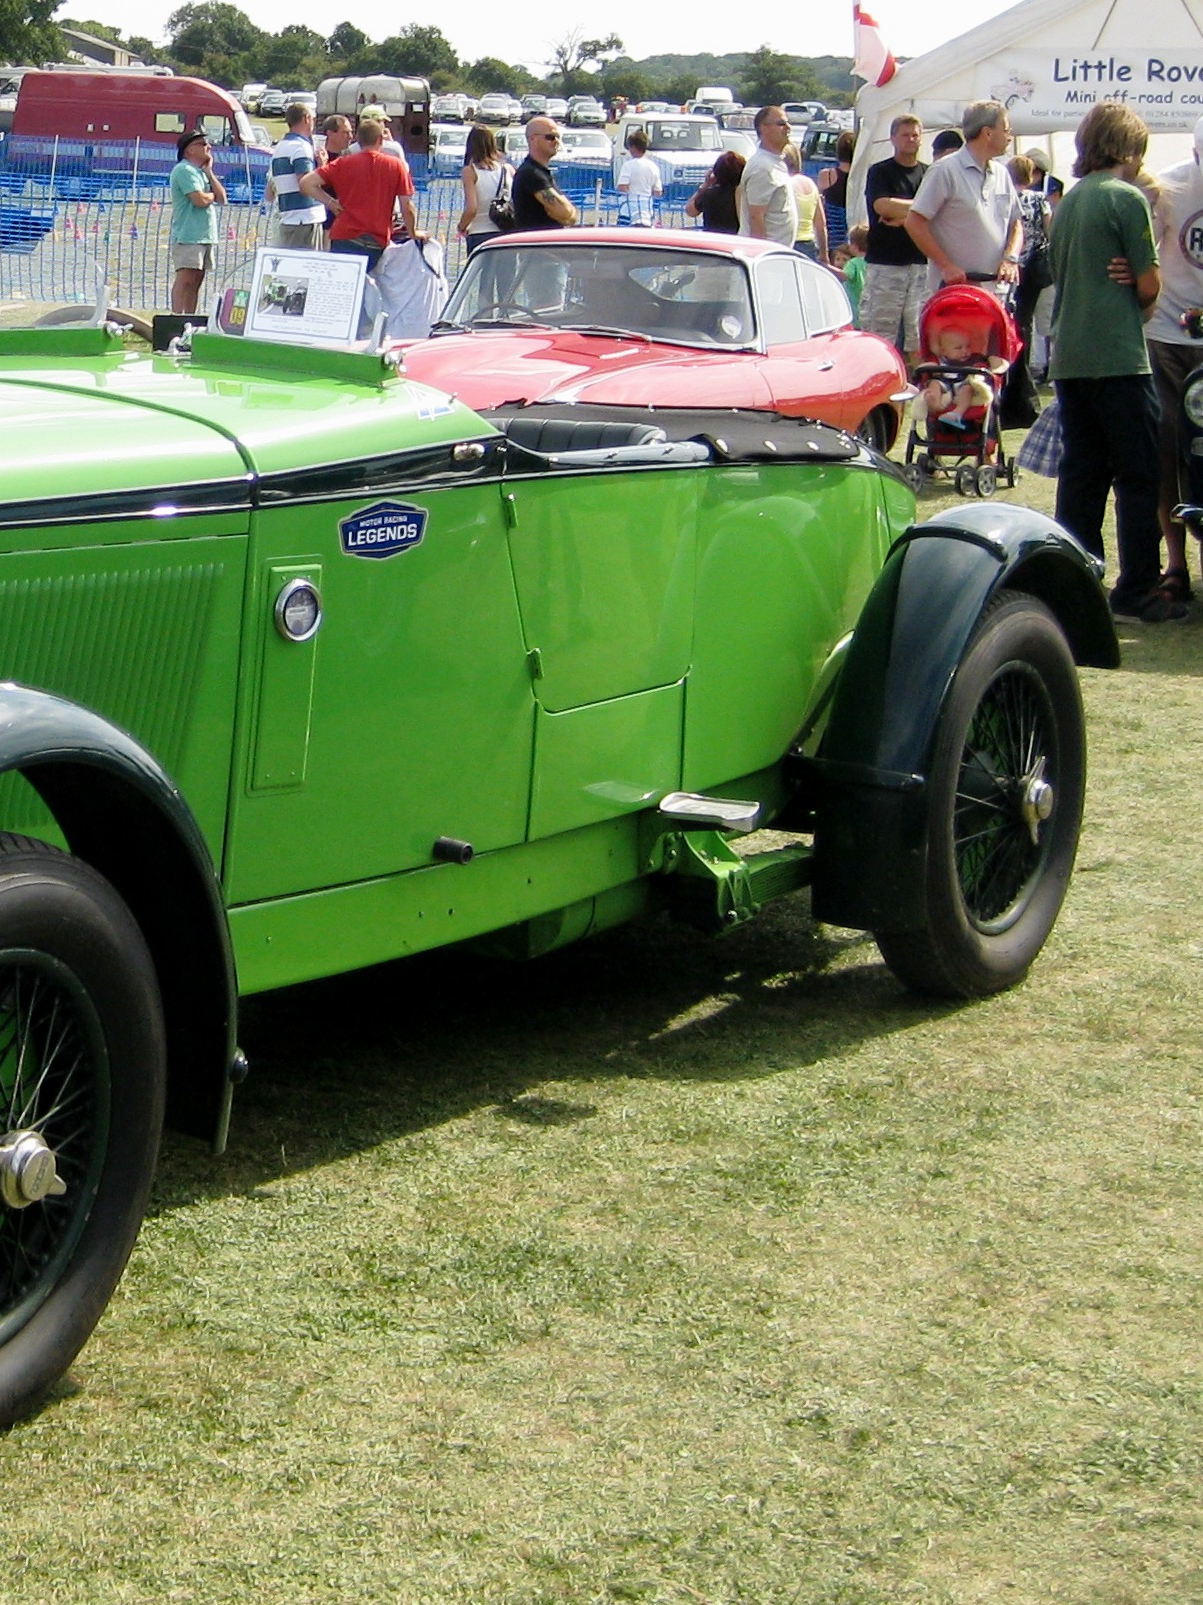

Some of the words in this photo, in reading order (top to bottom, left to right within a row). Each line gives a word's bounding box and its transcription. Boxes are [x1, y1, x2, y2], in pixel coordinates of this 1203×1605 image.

[1054, 58, 1132, 82] Little
[1065, 90, 1097, 103] Mini
[1103, 90, 1173, 104] off-road
[230, 307, 246, 325] 09
[360, 517, 382, 527] MOTOR
[348, 524, 417, 546] LEGENDS
